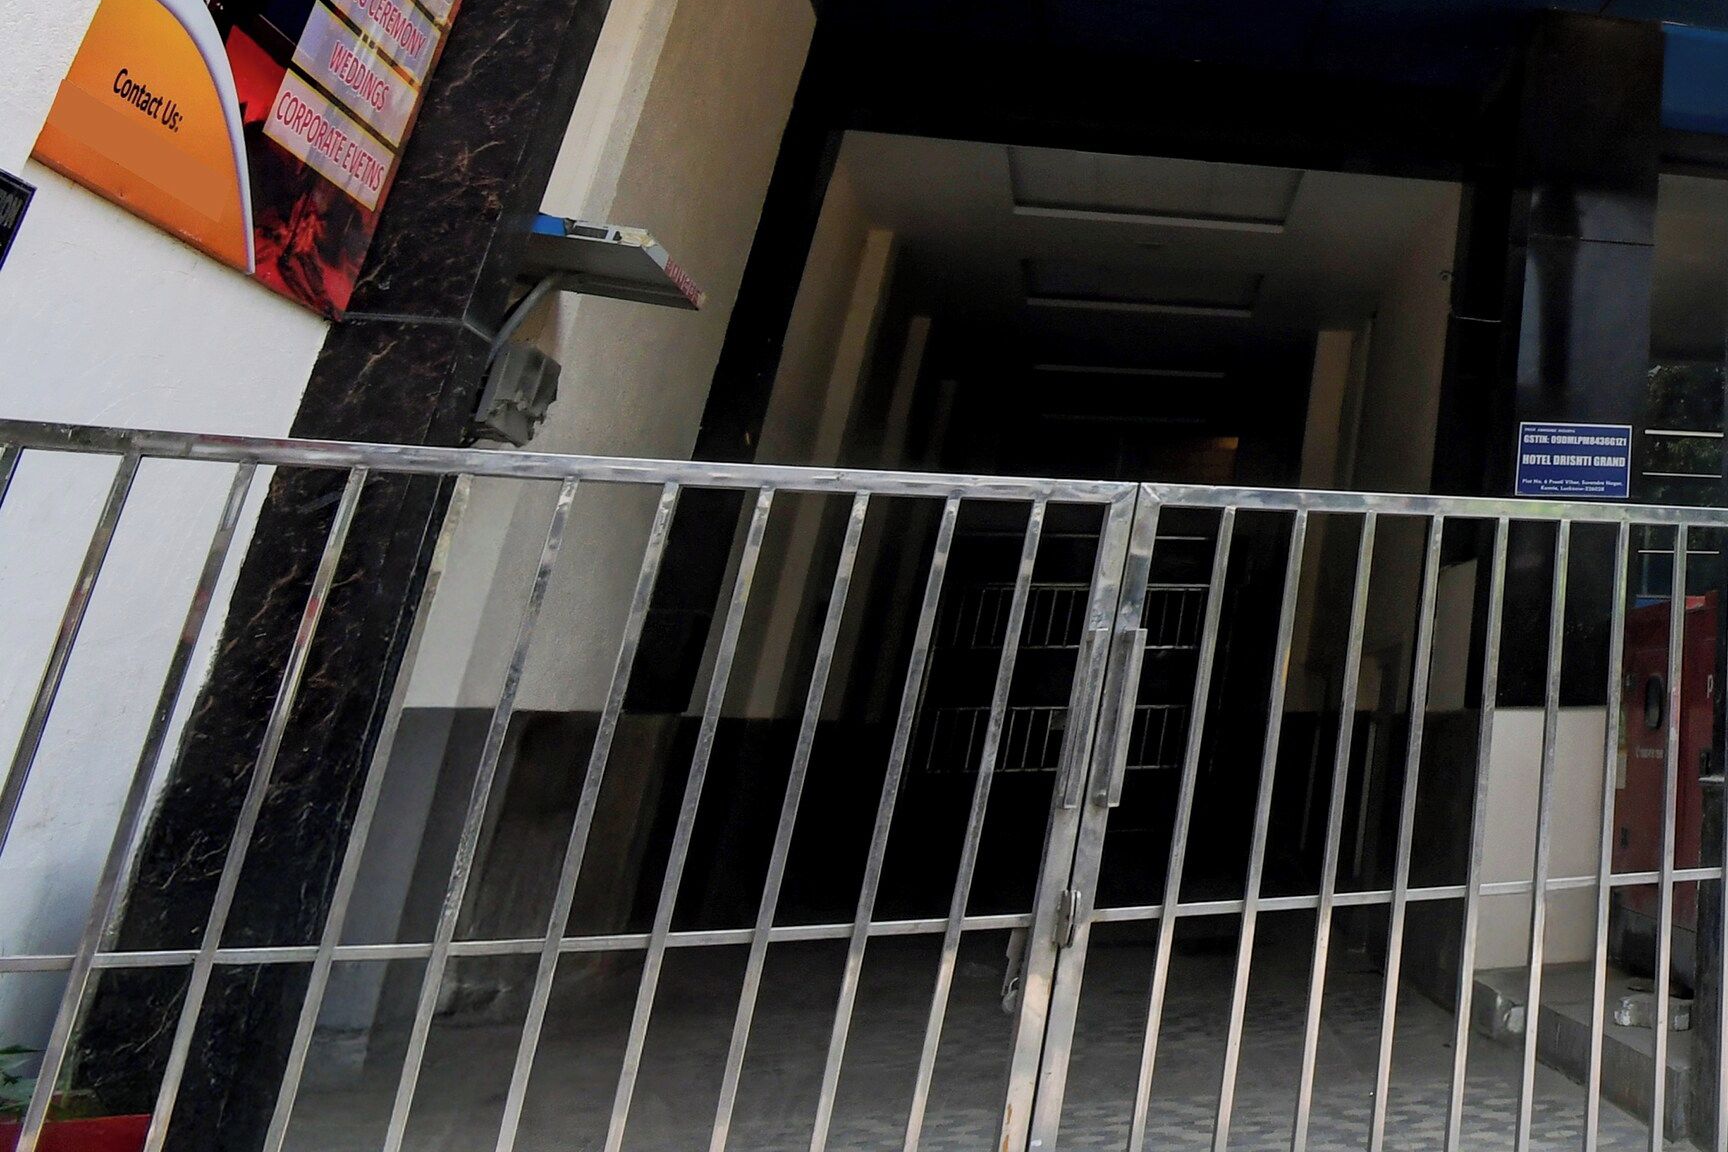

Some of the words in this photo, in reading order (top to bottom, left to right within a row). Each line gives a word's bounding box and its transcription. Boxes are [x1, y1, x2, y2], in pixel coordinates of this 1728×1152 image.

[113, 68, 164, 119] Contact
[161, 100, 183, 133] Us:
[329, 40, 390, 112] WEDDINGS
[276, 91, 347, 162] CORPORATE
[341, 143, 384, 191] EVETNS
[1522, 454, 1551, 465] HOTEL
[1553, 455, 1592, 466] DRISHTI
[1593, 456, 1626, 467] GRAND
